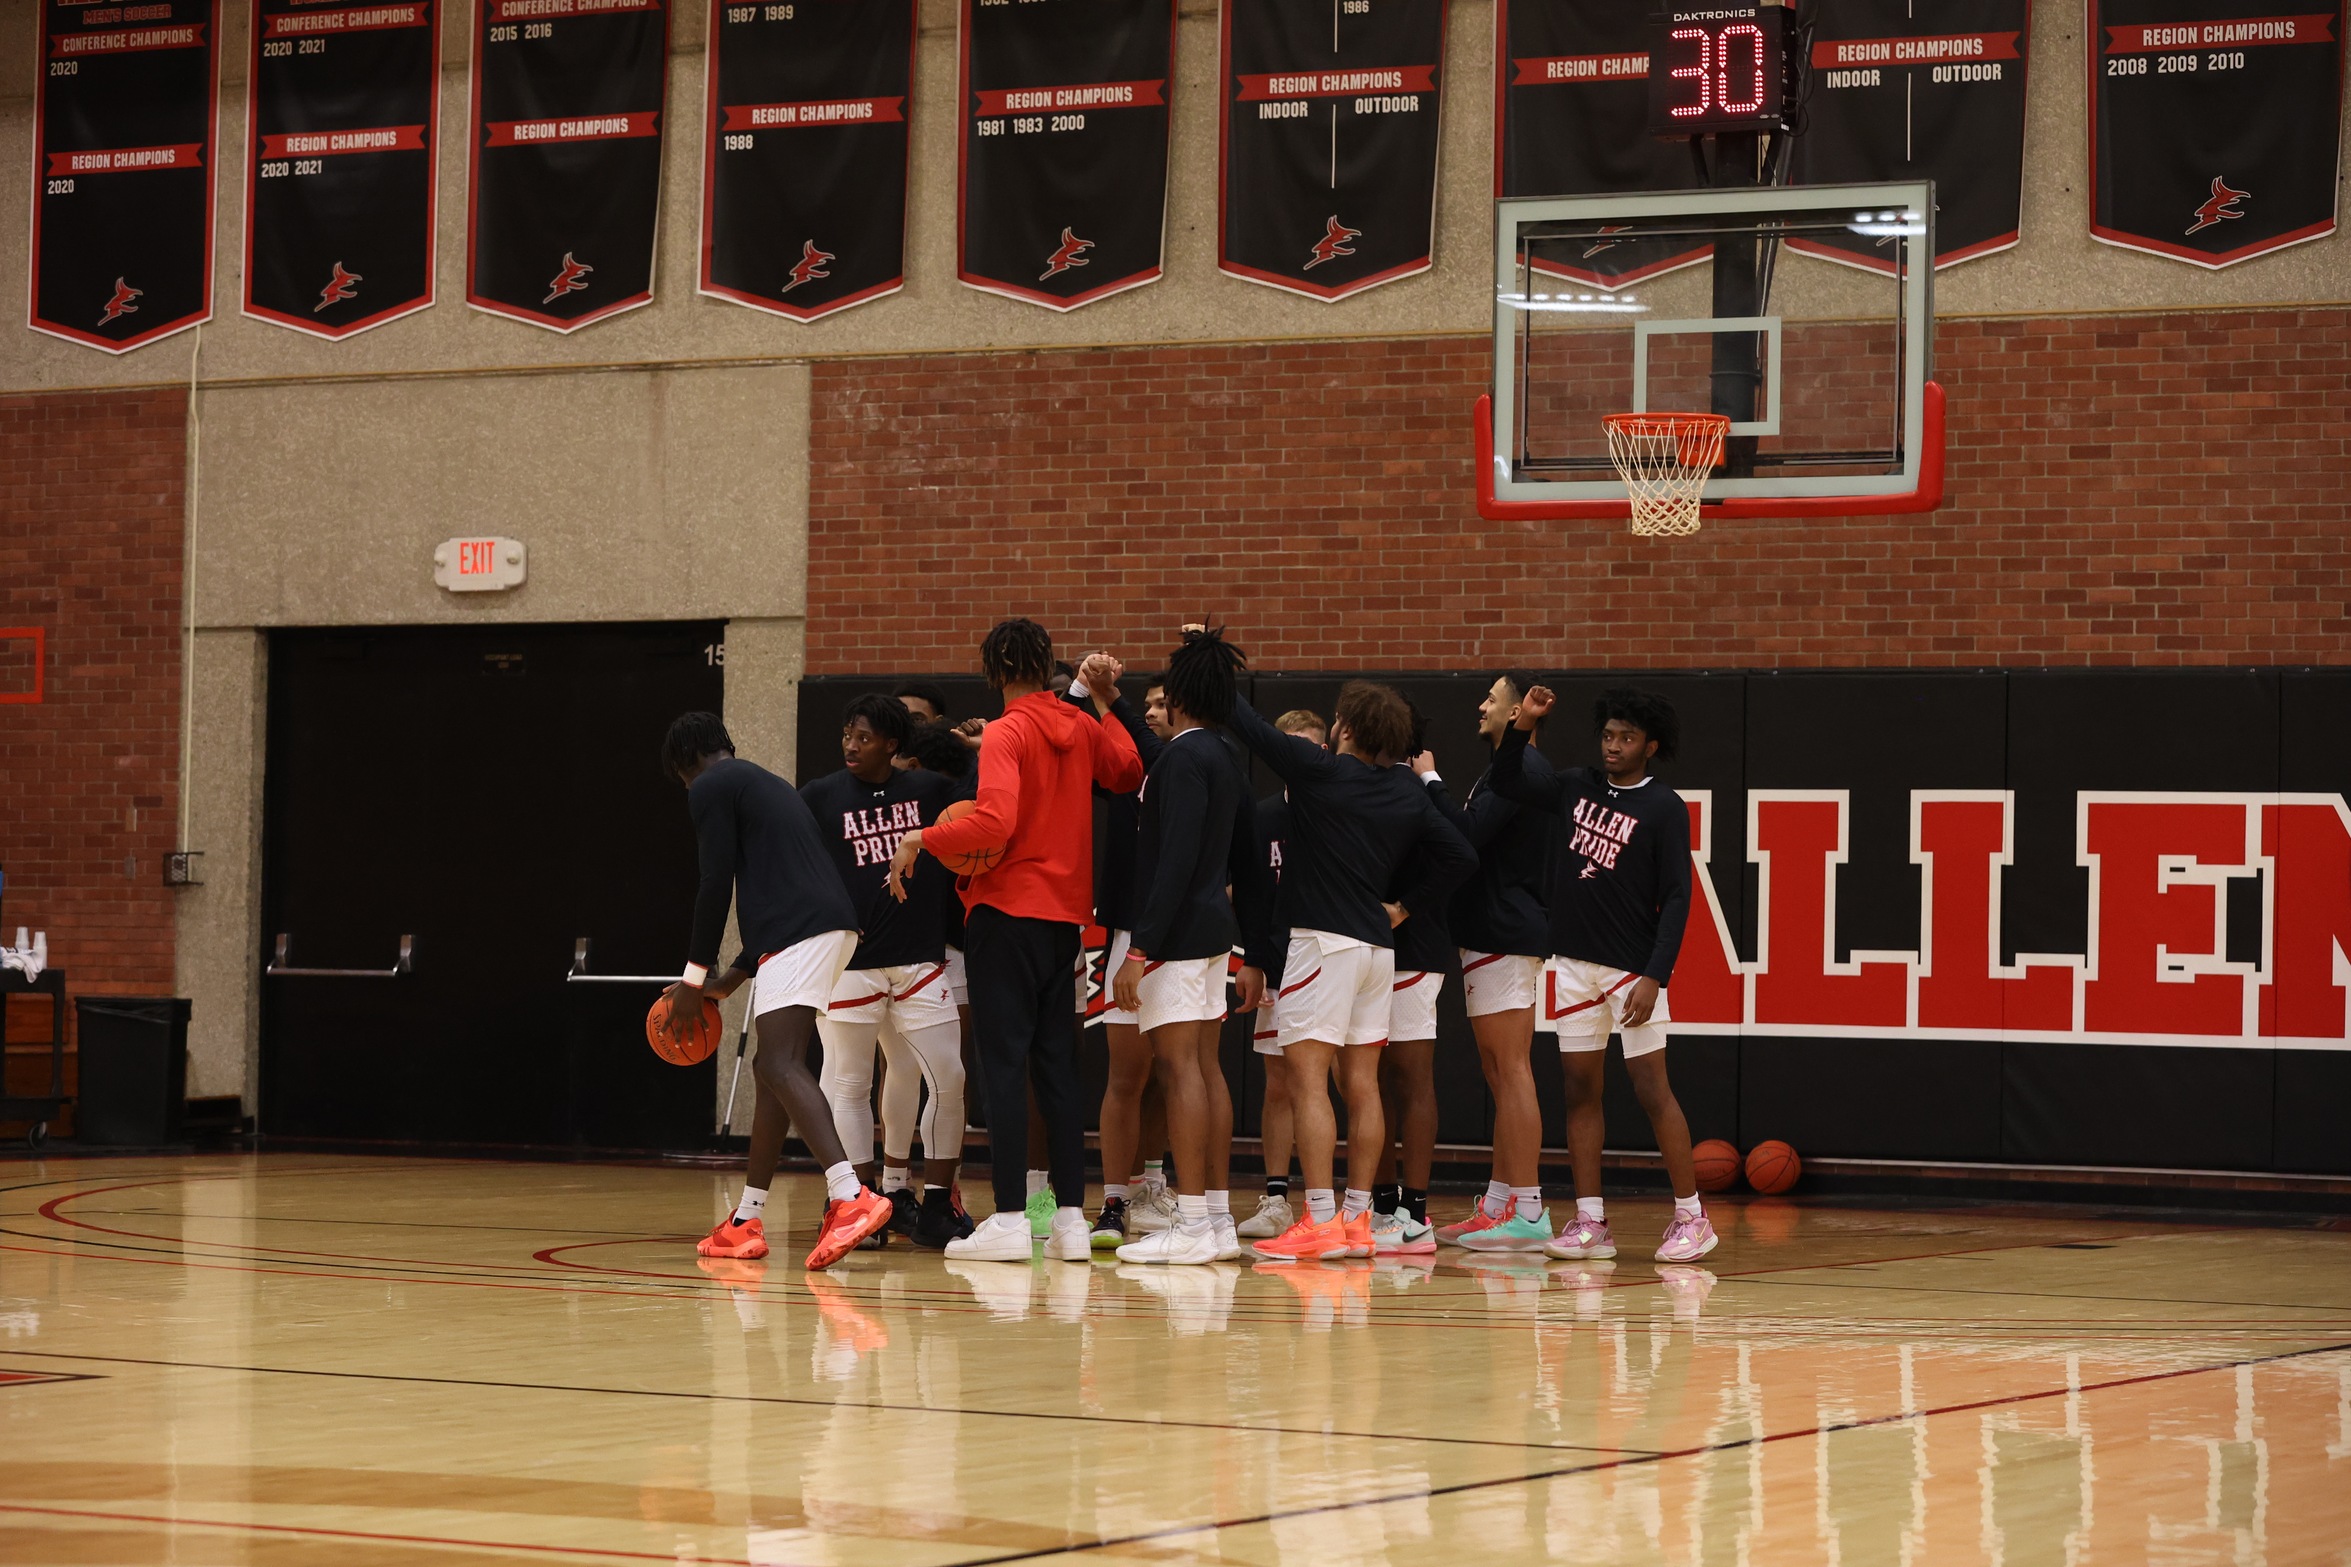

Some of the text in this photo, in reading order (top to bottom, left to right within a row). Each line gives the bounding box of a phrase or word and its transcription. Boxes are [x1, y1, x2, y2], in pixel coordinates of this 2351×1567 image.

[83, 4, 172, 24] MEN'S SOCCER
[502, 0, 574, 17] CONFERENCE
[727, 5, 794, 23] 1987 1989
[1343, 1, 1369, 14] 1986
[1673, 9, 1756, 22] DAKTRONICS
[277, 8, 415, 32] CONFERENCE CHAMPIONS
[63, 29, 193, 52] CONFERENCE CHAMPIONS
[490, 23, 552, 42] 2015 2016
[2143, 21, 2296, 47] REGION CHAMPIONS
[263, 39, 325, 57] 2020 2021
[1837, 38, 1984, 63] REGION CHAMPIONS
[51, 61, 78, 76] 2020
[1547, 60, 1600, 79] REGION
[1671, 25, 1764, 117] 30
[2107, 52, 2245, 76] 2008 2009 2010
[1269, 72, 1402, 95] REGION CHAMPIONS
[1827, 64, 2002, 89] INDOOR OUTDOOR
[1006, 86, 1133, 110] REGION CHAMPIONS
[1259, 96, 1419, 120] INDOOR OUTDOOR
[752, 102, 873, 125] REGION CHAMPIONS
[514, 118, 629, 141] REGION CHAMPIONS
[977, 115, 1085, 137] 1981 1983 2000
[286, 131, 397, 153] REGION CHAMPIONS
[724, 134, 754, 152] 1988
[72, 149, 175, 170] REGION CHAMPIONS
[261, 160, 323, 178] 2020 2021
[48, 180, 75, 195] 2020
[460, 542, 495, 574] EXIT
[843, 801, 921, 840] ALLEN
[1573, 797, 1639, 845] ALLEN
[1568, 826, 1622, 870] PRIDE
